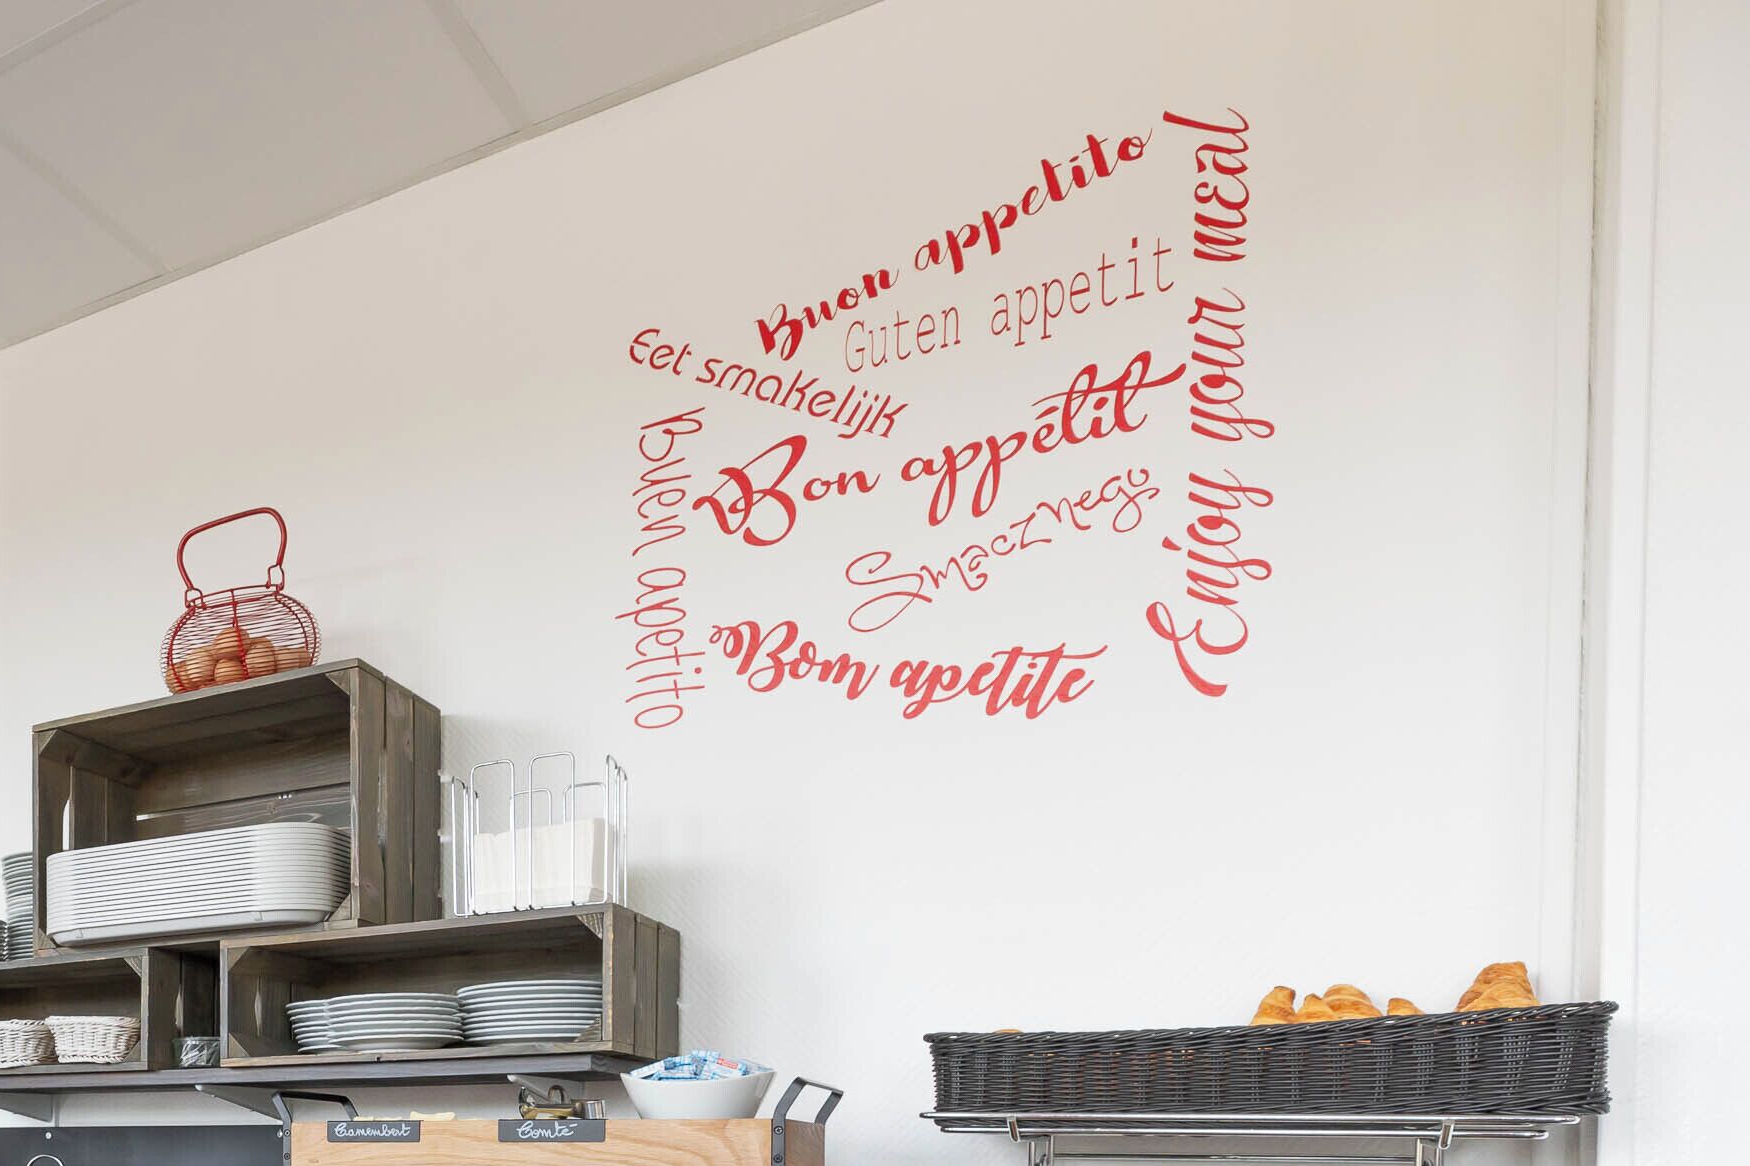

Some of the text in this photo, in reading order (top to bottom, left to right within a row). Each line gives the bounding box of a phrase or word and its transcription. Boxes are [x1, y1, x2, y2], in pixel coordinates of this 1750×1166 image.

[753, 130, 1153, 362] Buon appetito
[845, 238, 1174, 374] Guten appetit
[628, 327, 908, 440] Eet smakelijk
[693, 351, 1187, 548] Bon appétit
[1146, 107, 1275, 698] Enjoy your meal
[615, 406, 706, 730] Buen apetito
[845, 468, 1161, 633] Smacznego
[709, 620, 1108, 720] Bom apetite
[334, 1121, 411, 1138] Camembert
[516, 1122, 578, 1139] Comté
